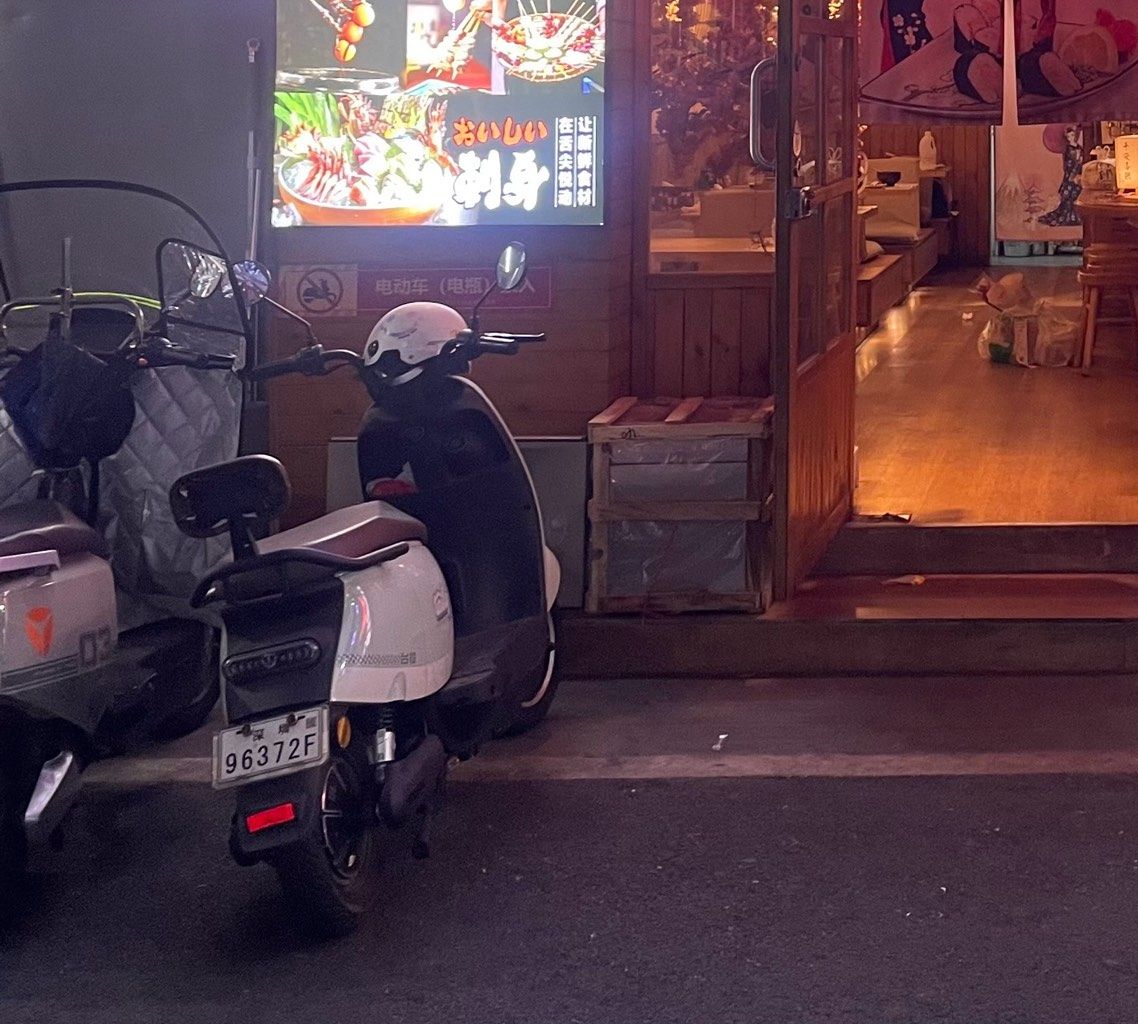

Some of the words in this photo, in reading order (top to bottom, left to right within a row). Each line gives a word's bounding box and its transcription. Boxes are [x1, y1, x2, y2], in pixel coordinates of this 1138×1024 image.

[453, 117, 548, 147] おいしい
[225, 733, 317, 774] 96372F
